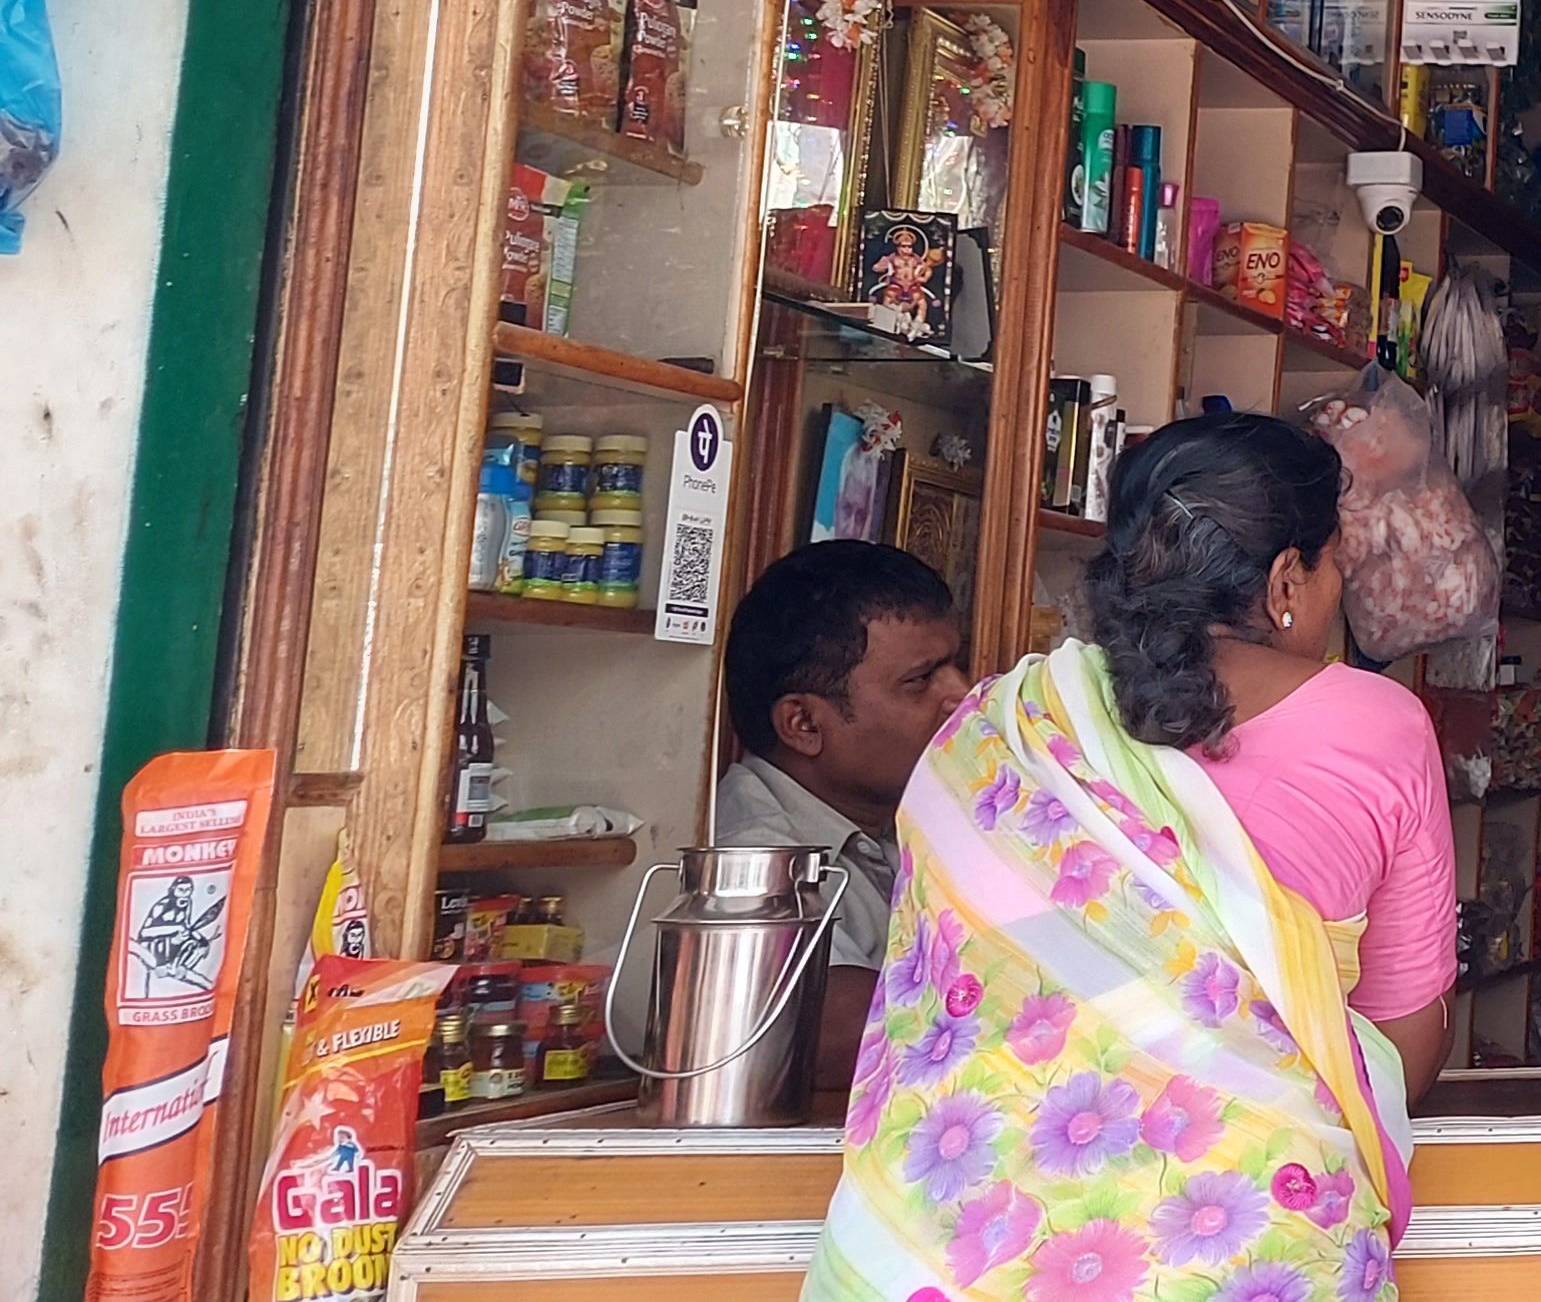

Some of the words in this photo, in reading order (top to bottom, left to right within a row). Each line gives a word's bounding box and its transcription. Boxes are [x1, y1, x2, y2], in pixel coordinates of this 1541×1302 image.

[1416, 12, 1472, 20] SENSODYNE
[1216, 245, 1240, 262] ENO
[1246, 251, 1281, 270] ENO
[682, 474, 717, 494] PhonePe
[140, 819, 197, 834] LARGEST
[142, 839, 236, 866] MONKEY
[133, 1009, 177, 1022] GRASS
[315, 1038, 330, 1056] &
[332, 1019, 401, 1053] FLEXIBLE
[274, 1161, 401, 1231] Gala
[277, 1230, 320, 1268] NO
[329, 1223, 397, 1263] DUST
